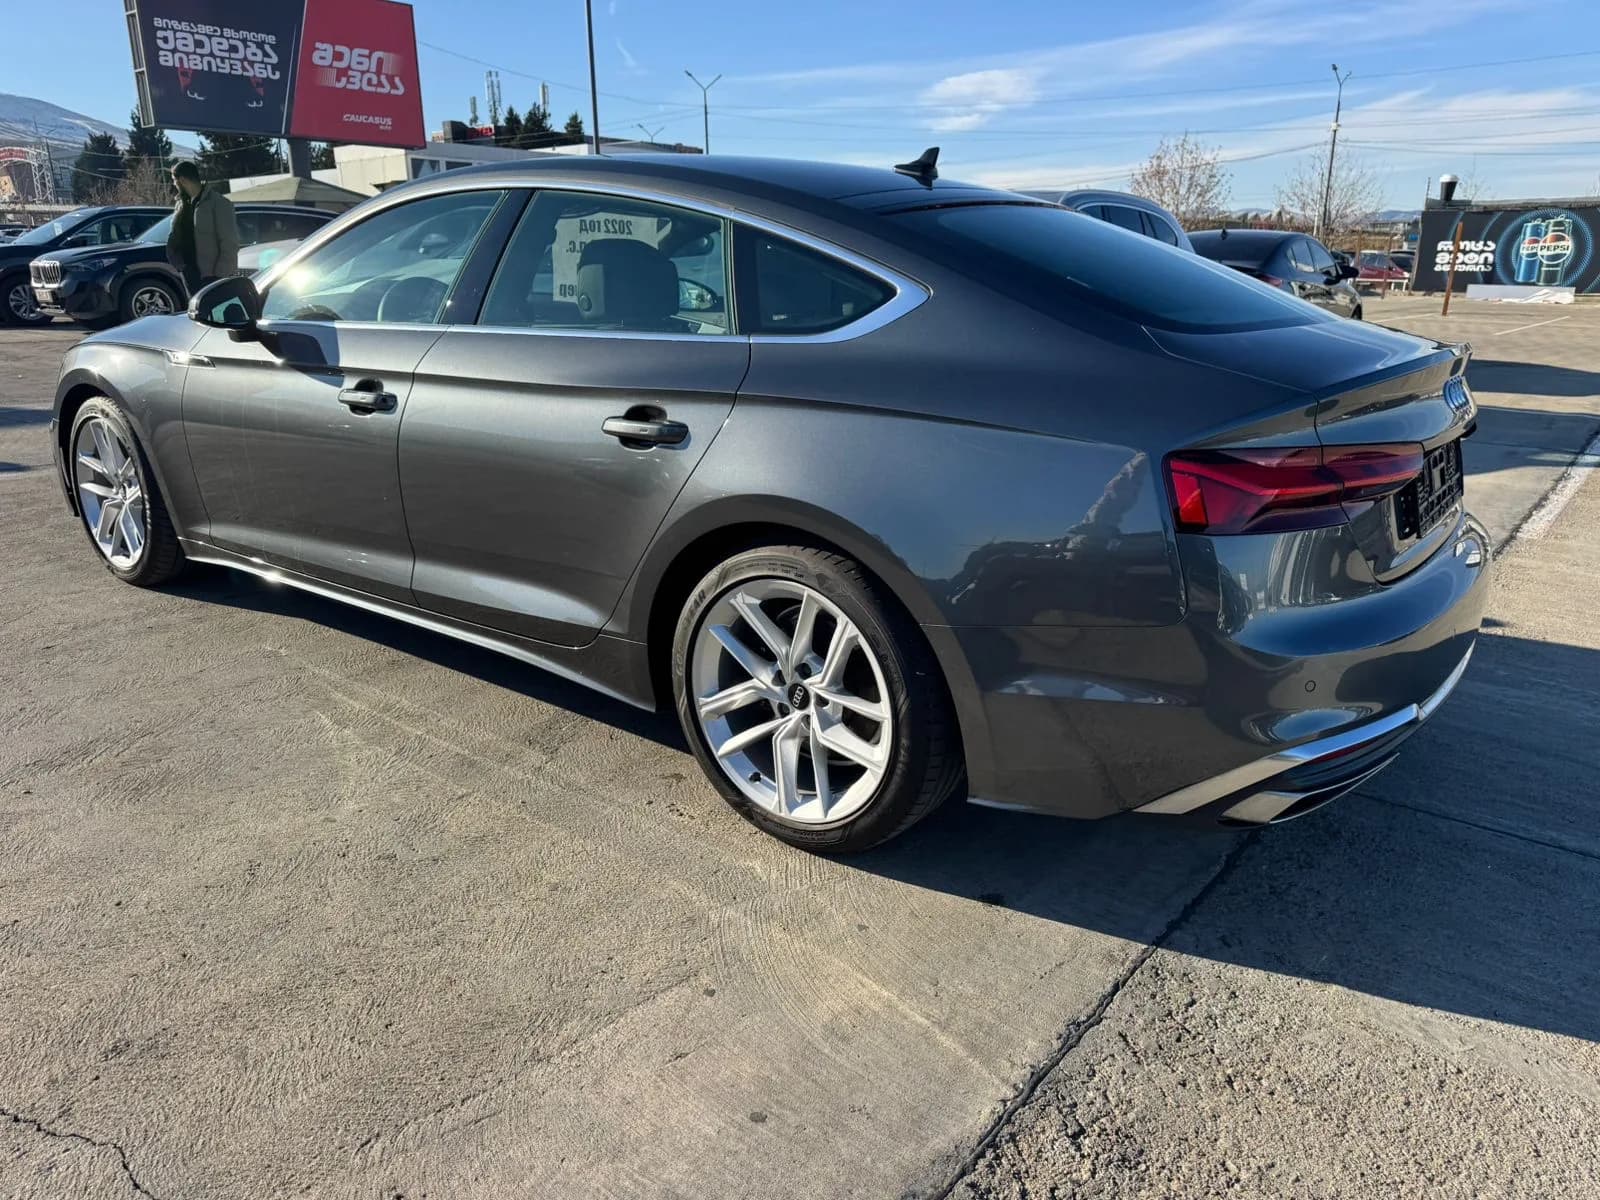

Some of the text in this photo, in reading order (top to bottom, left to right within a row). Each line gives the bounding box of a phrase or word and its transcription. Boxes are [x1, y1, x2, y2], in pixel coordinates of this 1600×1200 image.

[153, 17, 277, 44] მიზნამდე მხოლოდ
[156, 30, 279, 64] ქმედება
[312, 42, 391, 74] შენი
[158, 50, 281, 80] მიგიყვანს
[343, 113, 392, 125] CAUCASUS
[1539, 244, 1570, 252] PEPSI
